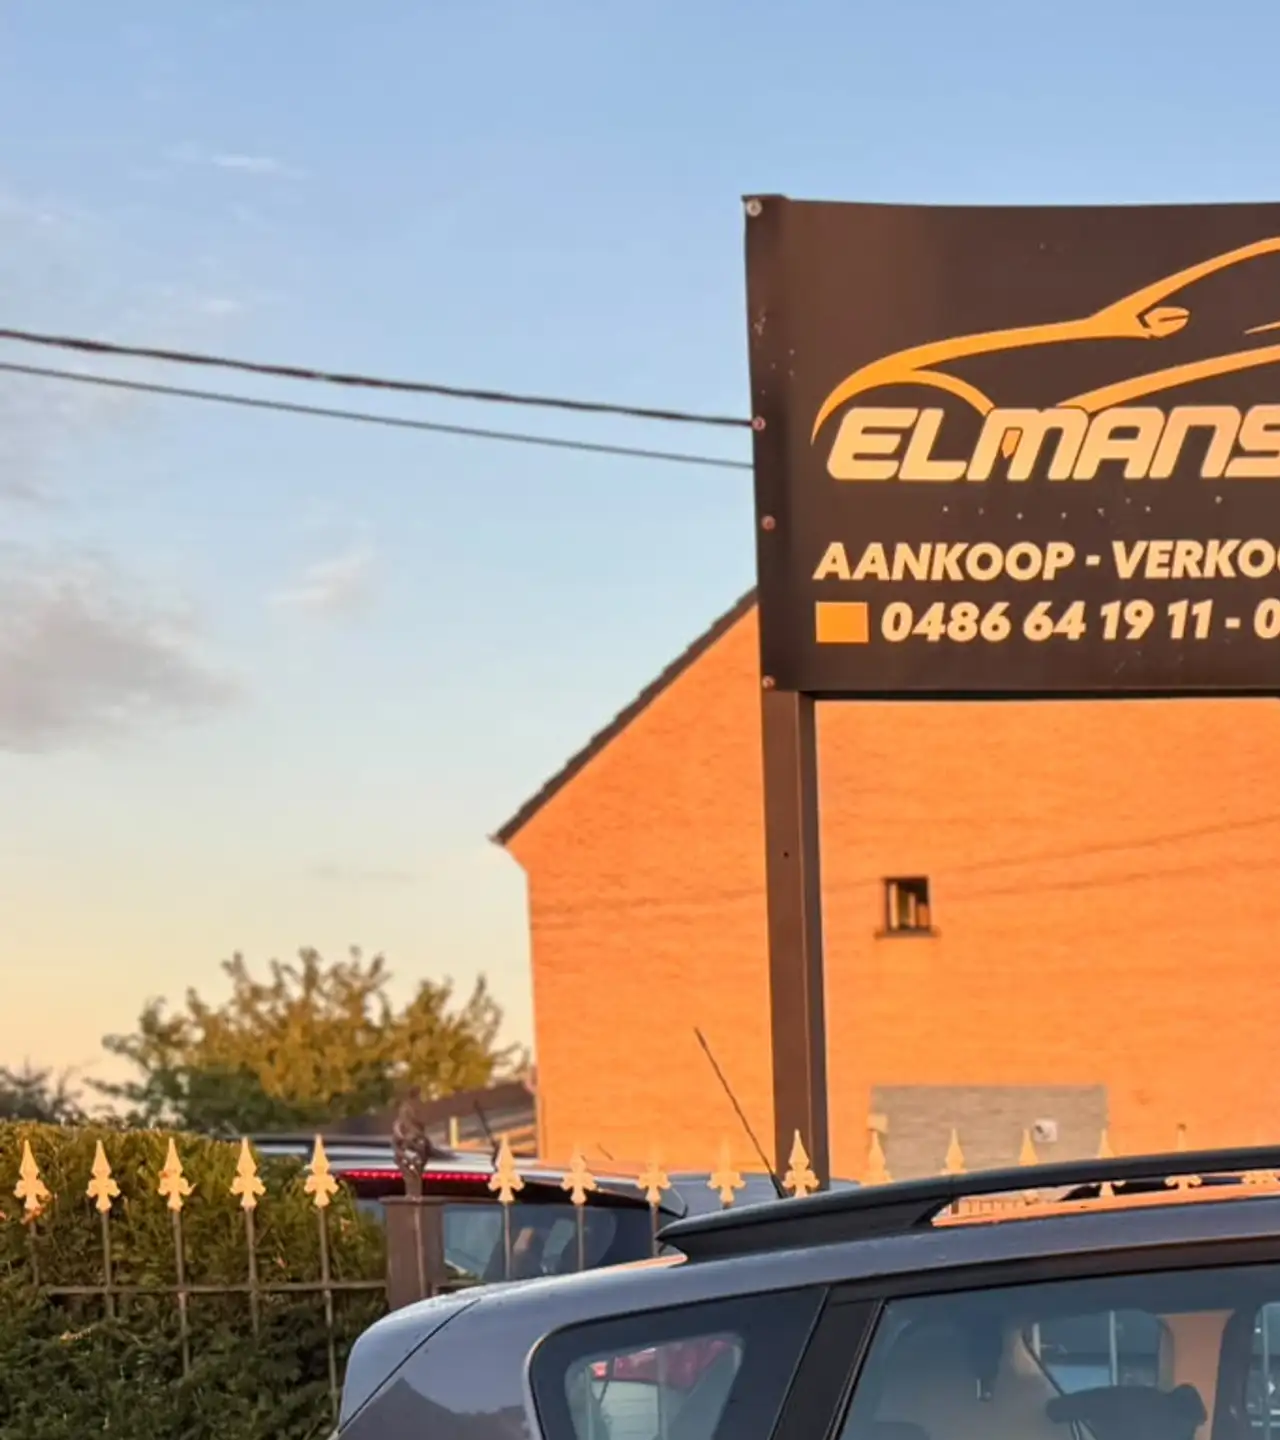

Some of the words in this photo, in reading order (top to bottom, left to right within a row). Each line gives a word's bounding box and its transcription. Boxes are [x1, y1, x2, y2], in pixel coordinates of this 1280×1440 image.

[813, 541, 1075, 582] AANKOOP
[880, 601, 1012, 644] 0486
[1022, 600, 1087, 642] 64
[1100, 599, 1155, 641] 19
[1167, 598, 1213, 640] 11
